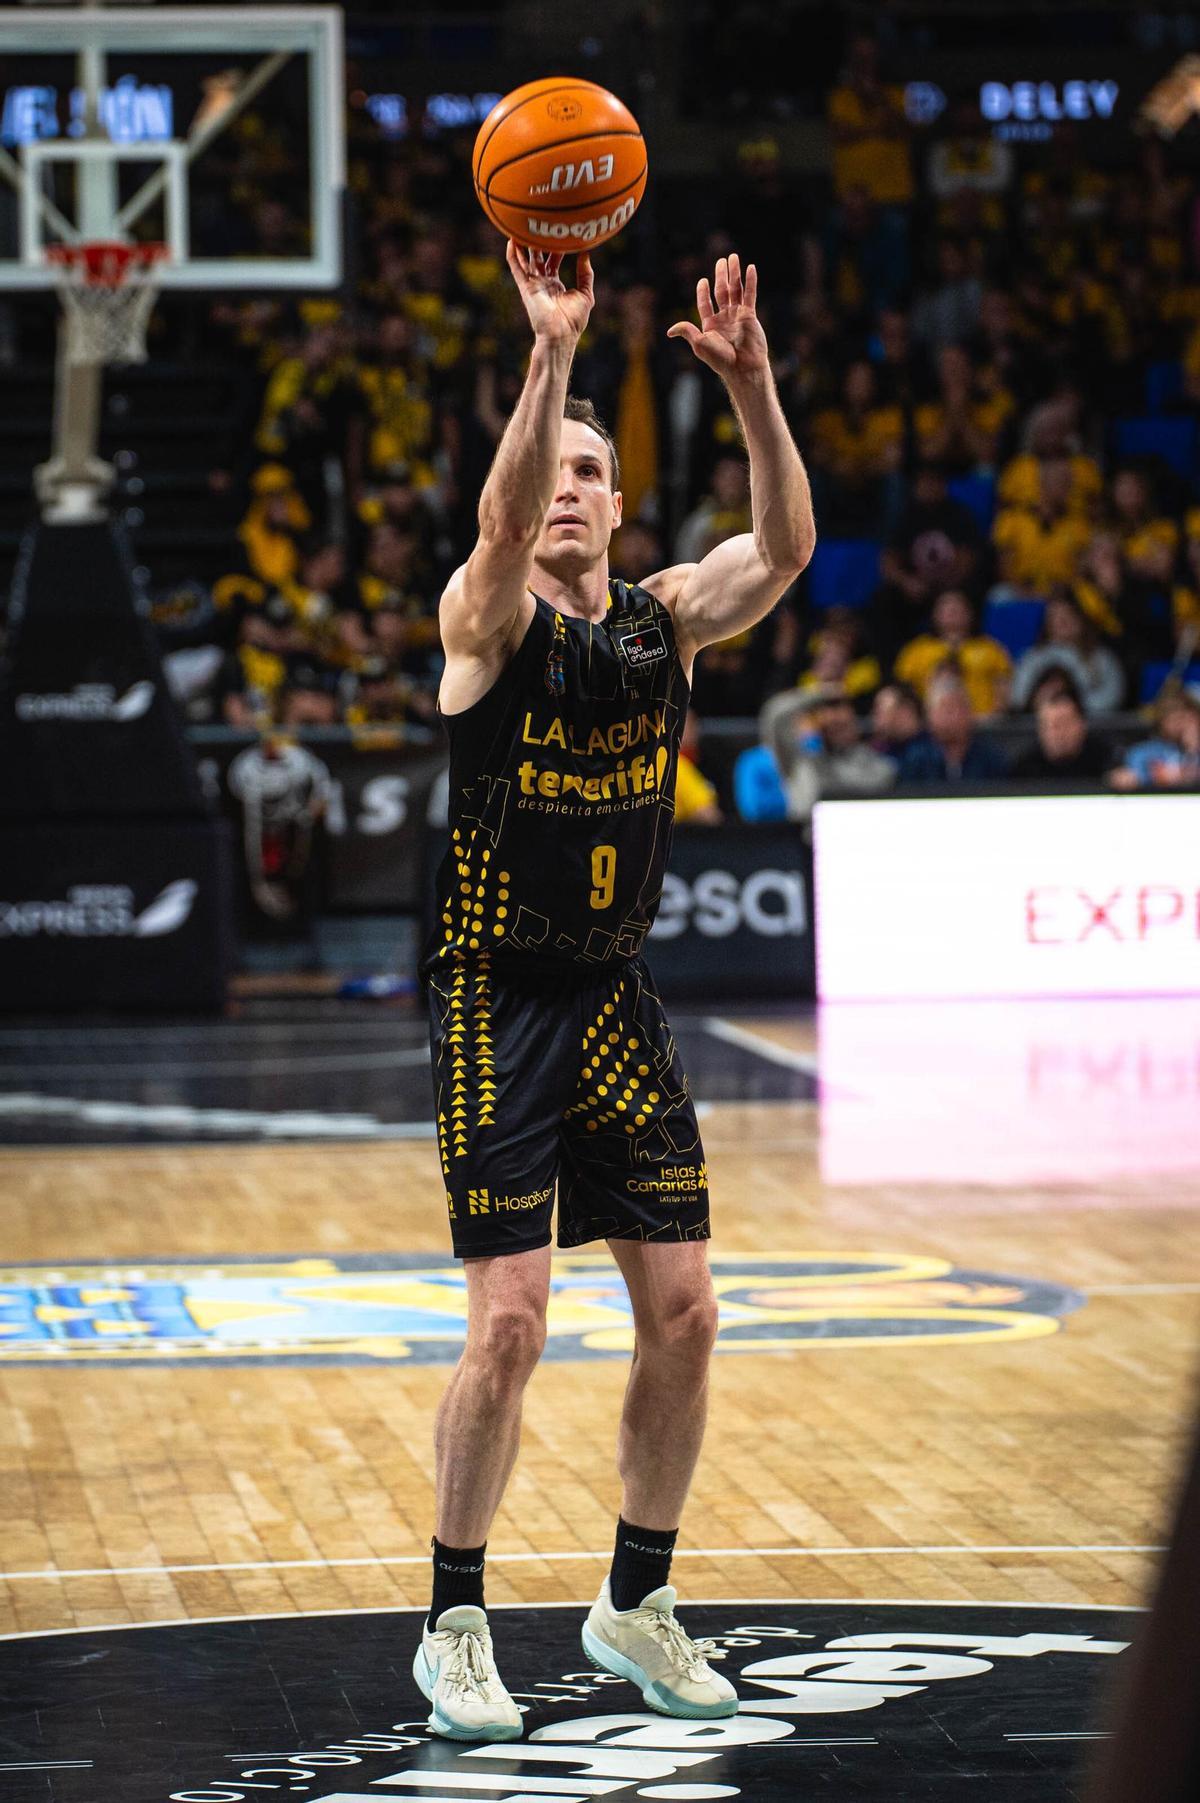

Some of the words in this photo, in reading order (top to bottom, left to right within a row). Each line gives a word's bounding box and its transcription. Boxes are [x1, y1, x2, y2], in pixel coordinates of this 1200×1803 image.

[627, 645, 643, 656] liga
[630, 647, 664, 662] endesa
[522, 712, 567, 749] LA
[517, 797, 592, 816] despierta
[596, 793, 656, 816] emociones
[589, 845, 617, 910] 9
[1025, 885, 1200, 943] EXP
[660, 1165, 696, 1180] Islas
[626, 1179, 697, 1192] Canarias
